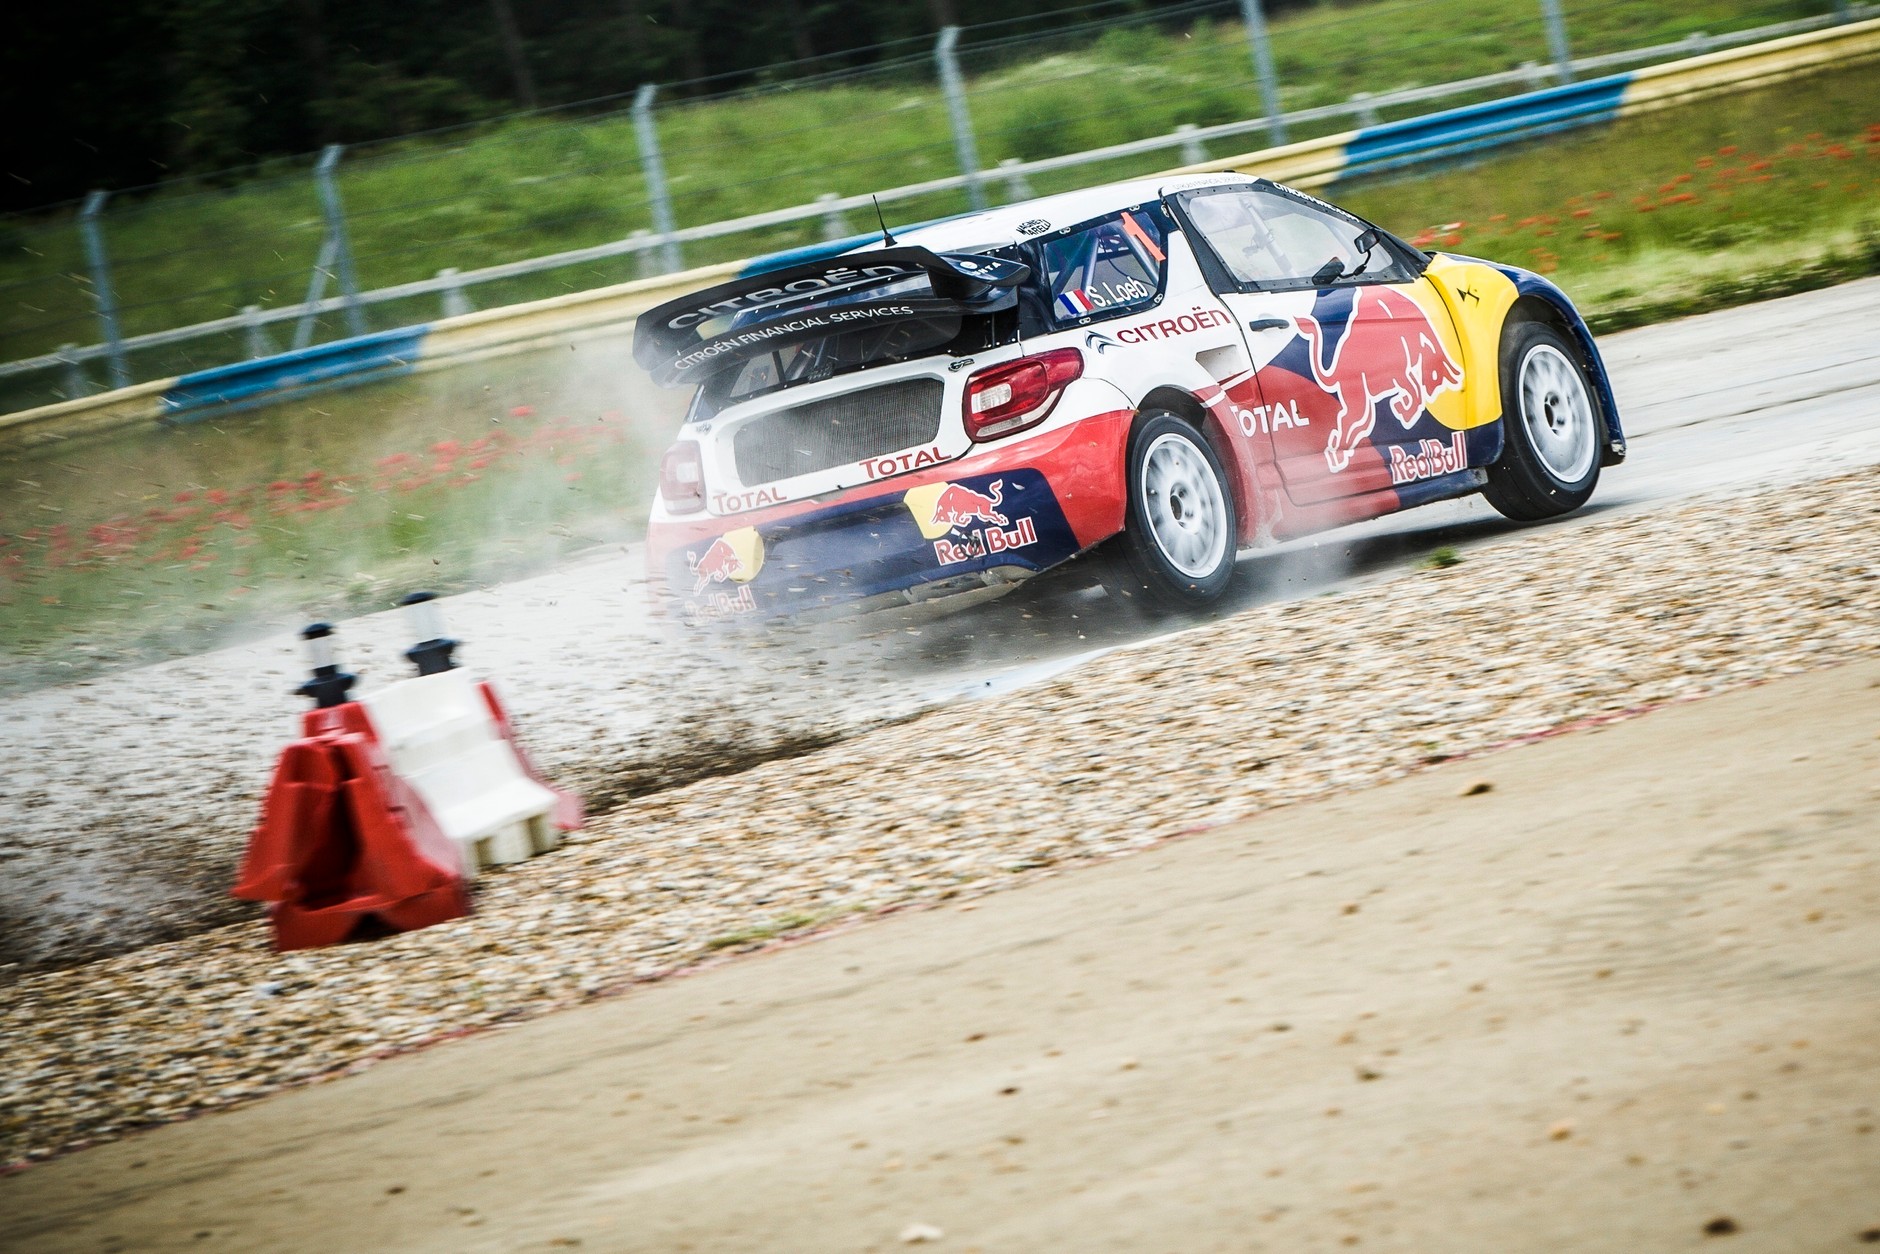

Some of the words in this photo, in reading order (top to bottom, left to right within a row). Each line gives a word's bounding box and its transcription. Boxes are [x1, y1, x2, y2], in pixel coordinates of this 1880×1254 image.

[668, 266, 906, 330] CITROËN
[1086, 285, 1111, 307] S.
[1102, 276, 1149, 302] Loeb
[739, 317, 830, 345] FINANCIAL
[832, 305, 914, 323] SERVICES
[1117, 306, 1231, 343] CITROËN
[859, 447, 952, 479] TOTAL
[1389, 439, 1431, 484] Red
[1429, 431, 1468, 476] Bull
[713, 487, 787, 513] TOTAL
[934, 531, 987, 566] Red
[985, 517, 1038, 555] Bull
[715, 584, 757, 616] Bull
